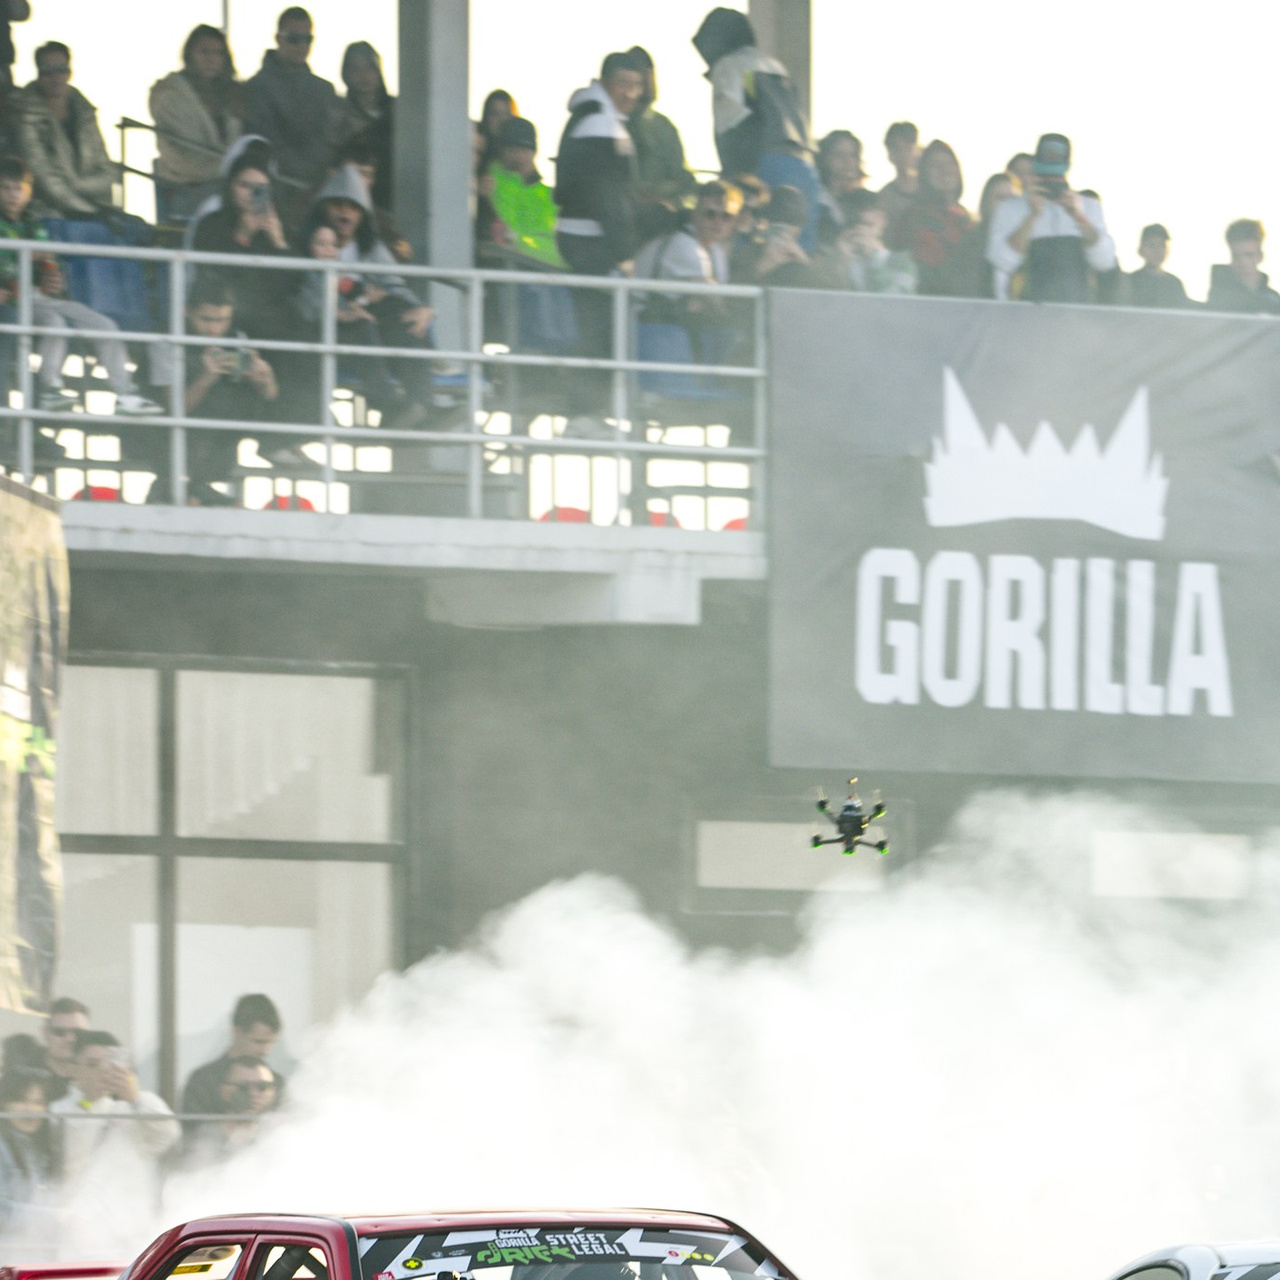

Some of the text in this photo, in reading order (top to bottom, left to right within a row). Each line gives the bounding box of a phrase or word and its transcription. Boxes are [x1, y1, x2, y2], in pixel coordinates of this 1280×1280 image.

[855, 547, 1234, 717] GORILLA
[494, 1236, 541, 1248] GORILLA
[545, 1233, 608, 1246] STREET
[571, 1243, 626, 1256] LEGAL
